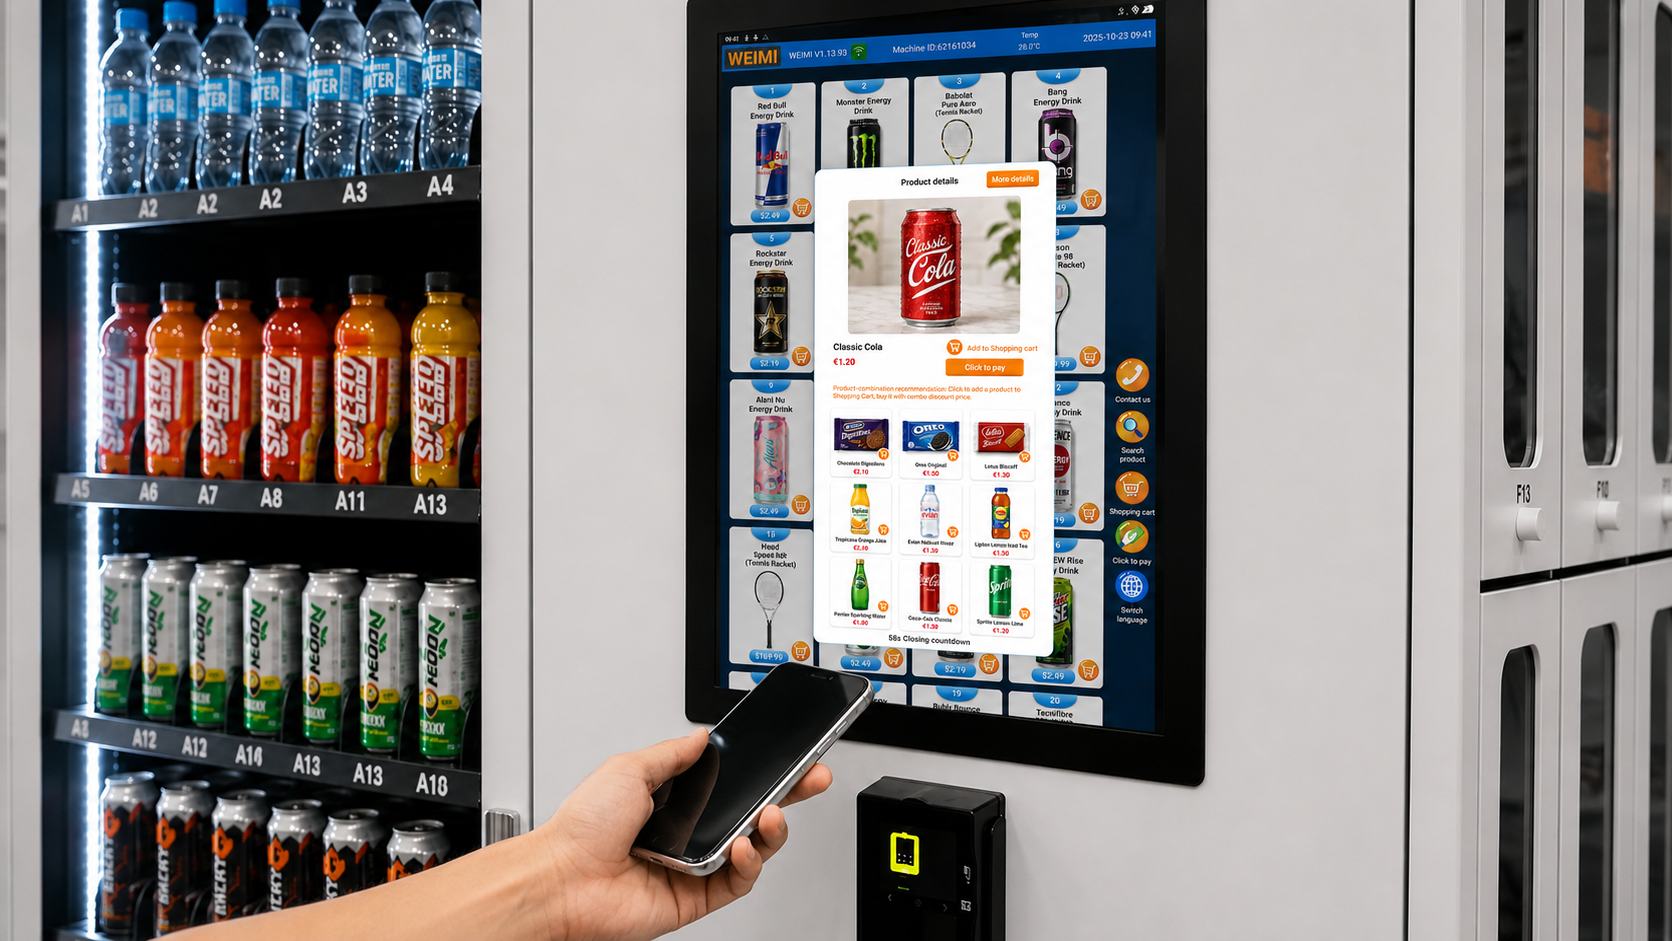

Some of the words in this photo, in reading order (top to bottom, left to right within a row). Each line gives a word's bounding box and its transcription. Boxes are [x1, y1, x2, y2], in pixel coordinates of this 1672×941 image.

[1083, 32, 1129, 43] 2025-10-23
[892, 43, 926, 54] Machine
[727, 49, 778, 66] WEIMI
[789, 51, 813, 60] WEIMI
[956, 77, 962, 85] 3
[1055, 72, 1061, 80] 4
[770, 87, 775, 95] 1
[861, 82, 867, 90] 2
[1047, 88, 1068, 97] Bang
[758, 101, 771, 110] Red
[773, 101, 787, 110] Bull
[836, 97, 866, 106] Monster
[867, 96, 892, 106] Energy
[1033, 98, 1060, 107] Energy
[1061, 97, 1082, 105] Drink
[854, 106, 873, 115] Drink
[750, 112, 774, 121] Energy
[775, 111, 795, 119] Drink
[1056, 166, 1073, 178] ng
[901, 178, 931, 188] Product
[932, 177, 959, 186] details
[991, 175, 1010, 184] More
[1011, 174, 1035, 183] details
[427, 174, 454, 198] A4
[342, 181, 368, 204] A3
[259, 187, 283, 210] A2
[138, 198, 159, 219] A2
[197, 193, 218, 215] A2
[71, 203, 89, 223] A1
[905, 234, 947, 258] Classic
[756, 250, 787, 258] Rockstar
[749, 259, 773, 268] Energy
[774, 259, 794, 267] Drink
[1057, 261, 1086, 269] Racket)
[907, 252, 957, 288] Cola
[833, 343, 863, 351] Classic
[864, 343, 883, 351] Cola
[990, 345, 1023, 353] Shopping
[833, 358, 856, 366] €1.20
[964, 363, 982, 371] Click
[992, 365, 1006, 373] pay
[1115, 396, 1141, 404] Contact
[749, 405, 773, 414] Energy
[774, 405, 793, 413] Drink
[1062, 408, 1082, 417] Drink
[71, 479, 90, 499] A5
[139, 482, 159, 502] A6
[1516, 484, 1531, 504] F13
[197, 484, 219, 505] A7
[259, 487, 283, 508] A8
[334, 490, 365, 512] A11
[413, 493, 447, 515] A13
[1109, 507, 1141, 517] Shopping
[1142, 508, 1156, 516] cart
[1067, 557, 1084, 565] Rise
[1112, 557, 1130, 565] Click
[1139, 559, 1152, 567] pay
[1058, 567, 1079, 575] Drink
[1116, 614, 1148, 625] language
[888, 634, 901, 642] 58s
[902, 635, 930, 645] Closing
[931, 637, 971, 646] countdown
[952, 689, 962, 698] 19
[1049, 696, 1060, 704] 20
[131, 728, 157, 750] A12
[181, 735, 208, 758] A12
[292, 752, 321, 777] A13
[353, 762, 384, 787] A13
